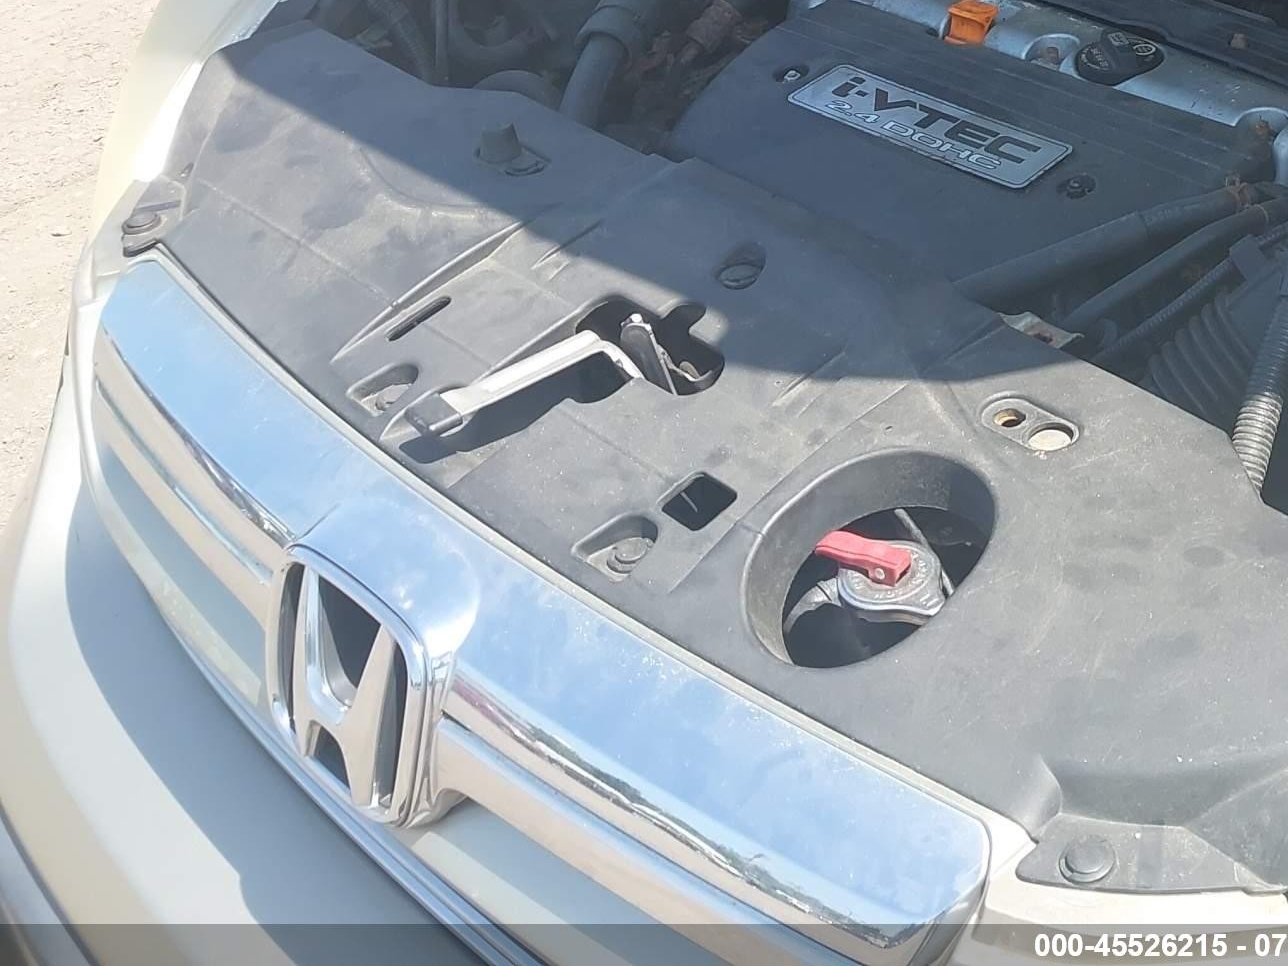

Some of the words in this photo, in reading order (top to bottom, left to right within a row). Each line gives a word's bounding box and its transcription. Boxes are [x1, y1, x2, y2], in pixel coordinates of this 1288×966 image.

[825, 100, 881, 124] 2.4
[882, 120, 1002, 170] DOHC
[831, 76, 1041, 164] i-VTEC
